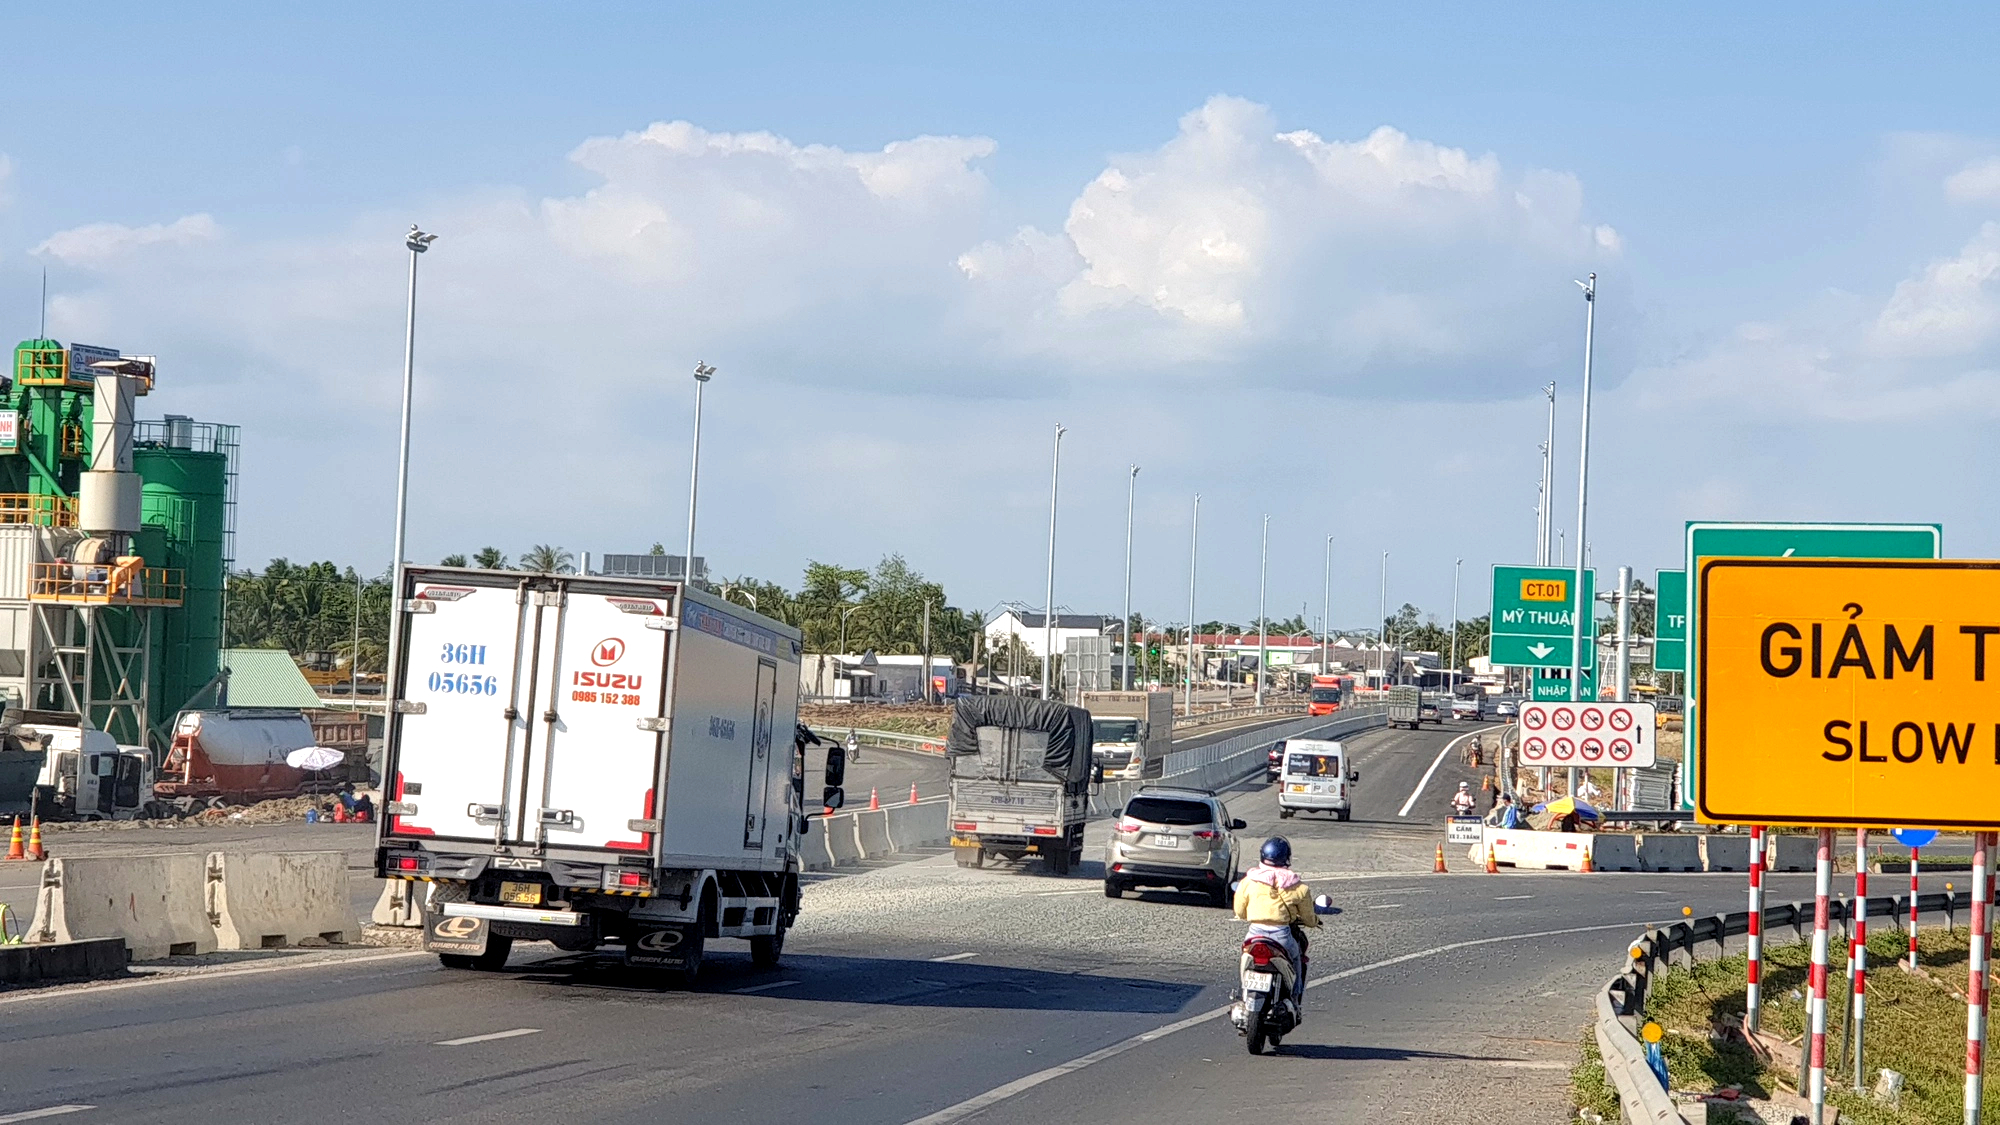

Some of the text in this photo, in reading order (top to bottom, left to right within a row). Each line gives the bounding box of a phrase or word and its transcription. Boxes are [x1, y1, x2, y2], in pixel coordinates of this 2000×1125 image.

[1526, 583, 1560, 598] CT.01
[1502, 608, 1525, 624] MỸ
[1760, 602, 2000, 682] GIẢM T
[441, 642, 487, 665] 36H
[428, 671, 497, 696] 05656
[573, 671, 642, 690] ISUZU
[572, 690, 641, 706] 0985 152 388
[1537, 684, 1568, 698] NHẬP
[1821, 719, 1976, 765] SLOW
[513, 883, 531, 893] 36H
